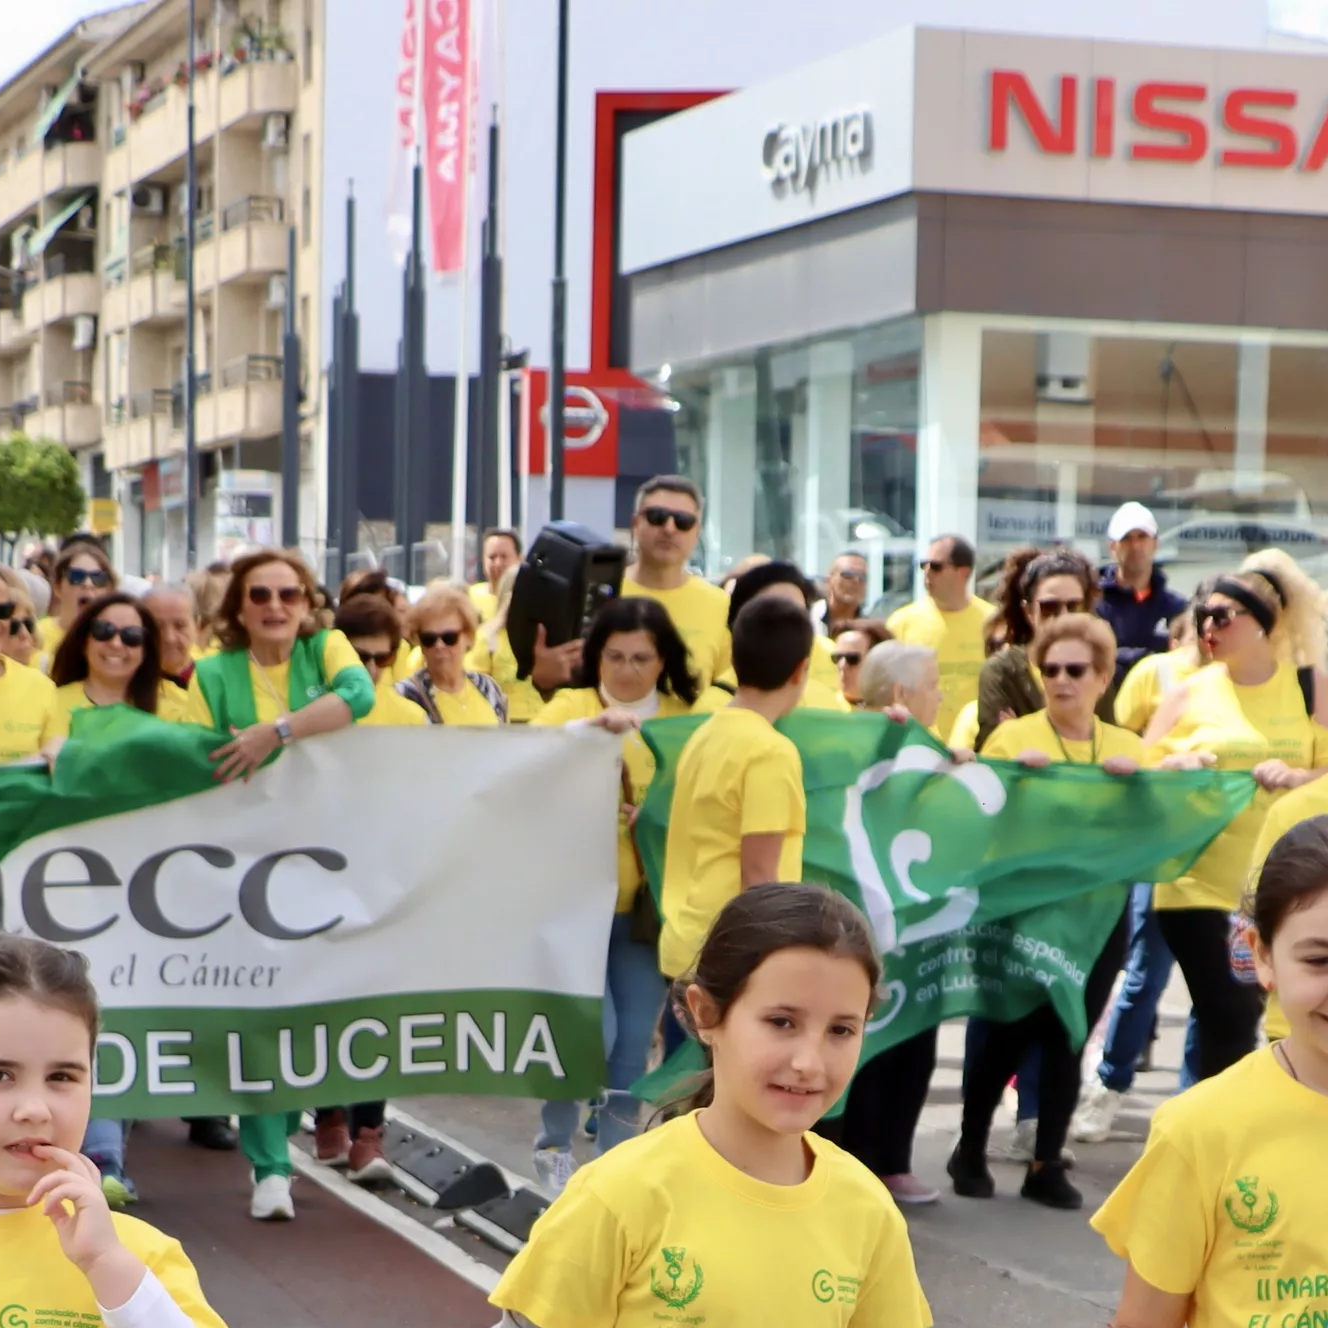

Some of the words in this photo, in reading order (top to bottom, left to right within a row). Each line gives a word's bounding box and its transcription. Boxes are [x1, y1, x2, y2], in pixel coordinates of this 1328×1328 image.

[109, 953, 137, 987] el
[158, 953, 281, 989] Cáncer
[91, 1030, 197, 1096] DE
[226, 1010, 567, 1093] LUCENA
[1256, 1278, 1271, 1301] II
